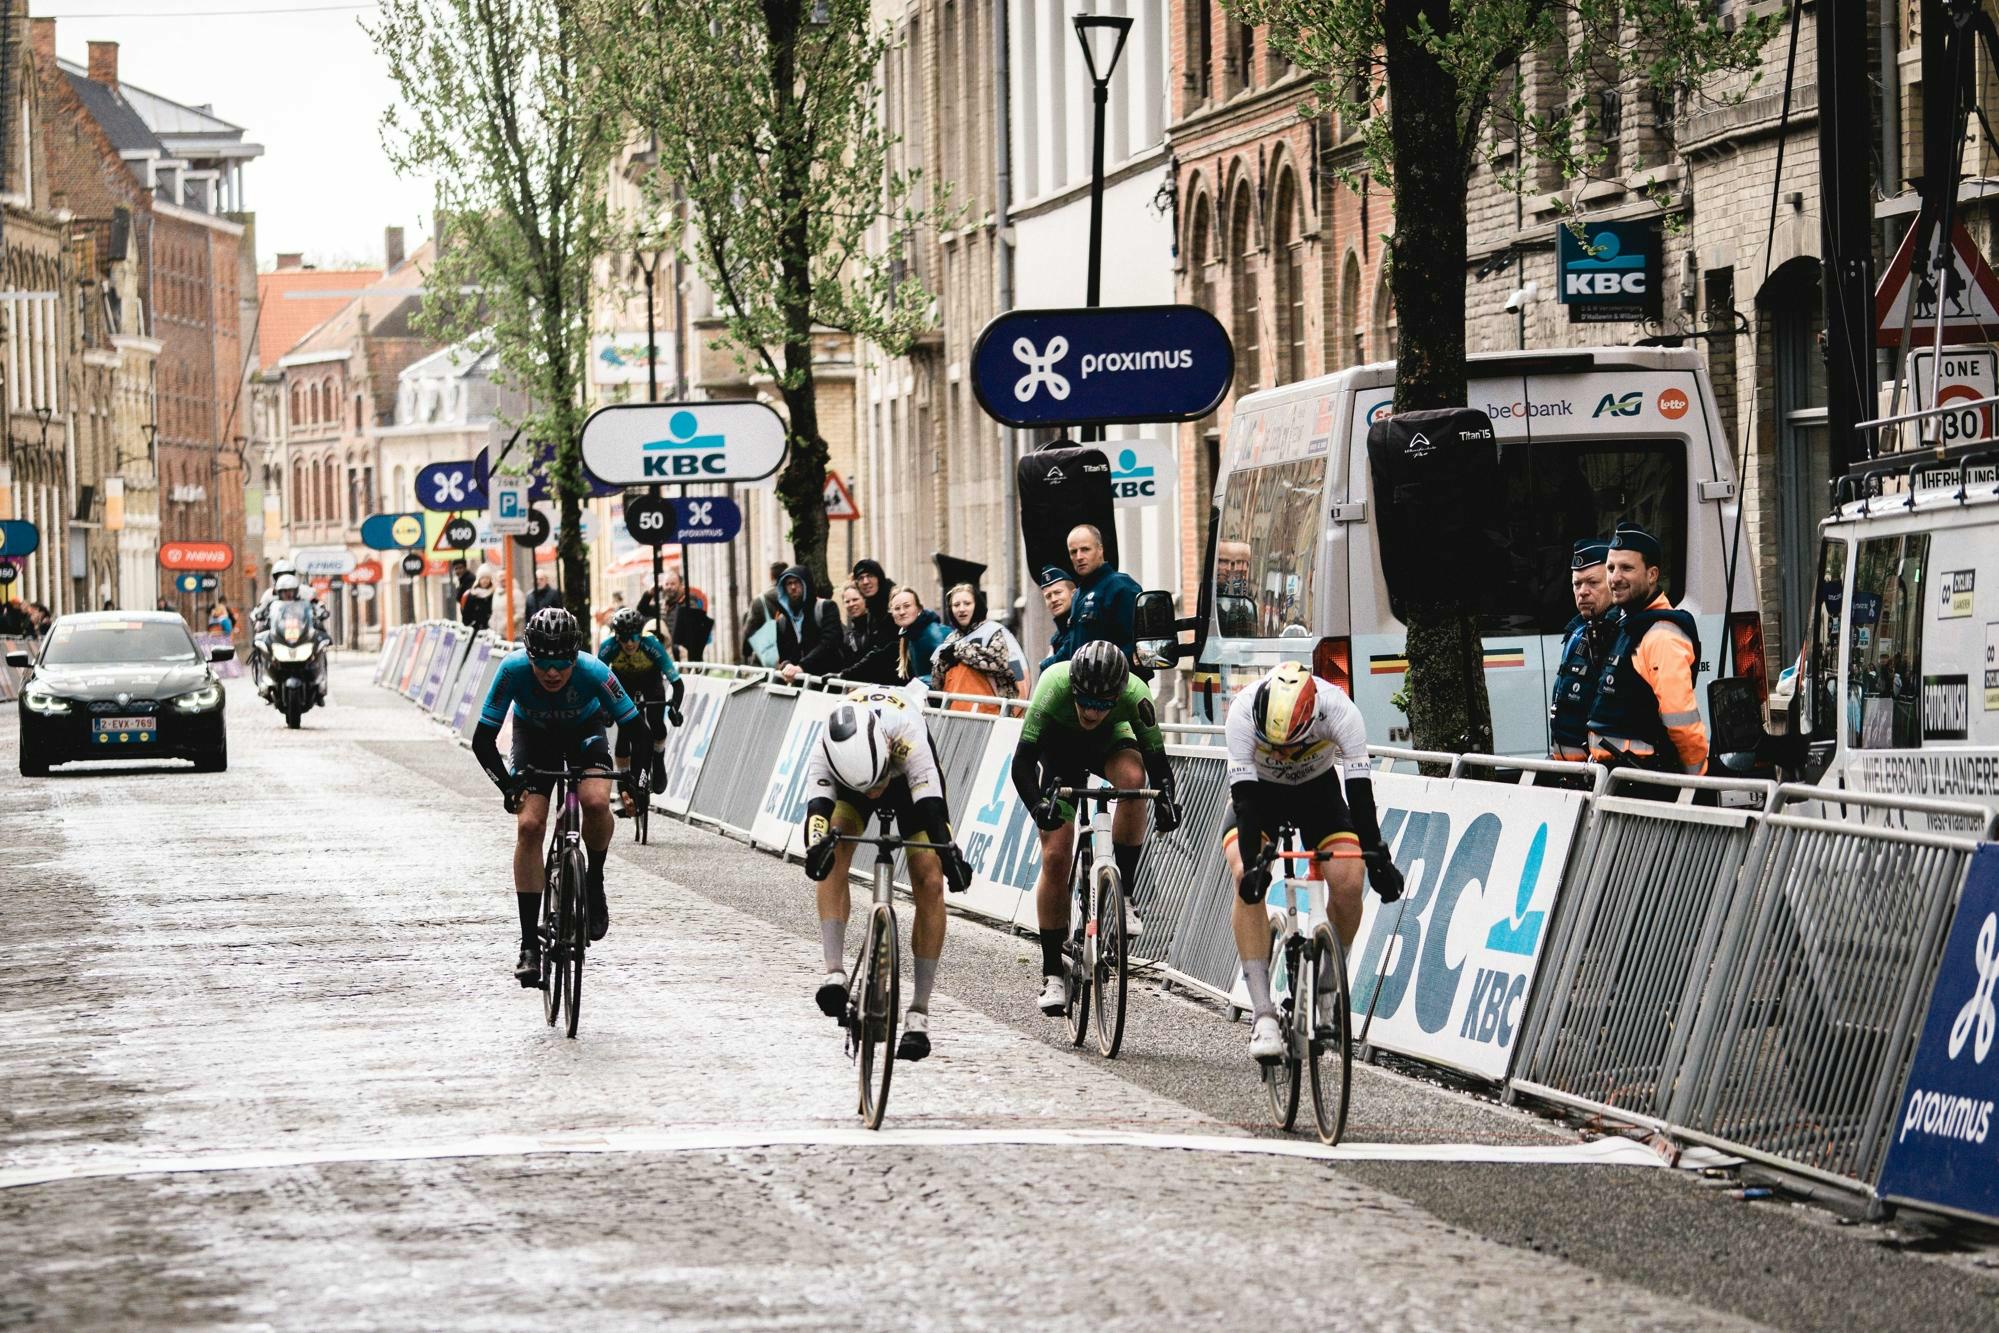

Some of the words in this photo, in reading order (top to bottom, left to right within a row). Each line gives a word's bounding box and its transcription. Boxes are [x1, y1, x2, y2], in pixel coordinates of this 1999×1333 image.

[1566, 272, 1645, 295] KBC
[1081, 350, 1193, 379] proximus
[1939, 360, 1980, 377] ONE
[1592, 392, 1643, 418] AG
[1459, 430, 1480, 441] Titan
[643, 453, 726, 477] KBC
[1926, 470, 1995, 489] HERHLING
[638, 511, 664, 529] 50
[450, 527, 472, 540] 100
[678, 528, 724, 541] proximus
[1924, 684, 1967, 731] FOTOFINISH
[1862, 756, 1928, 795] WIELERBOND
[1460, 968, 1527, 1049] KBC
[1900, 1089, 1994, 1144] proximus
